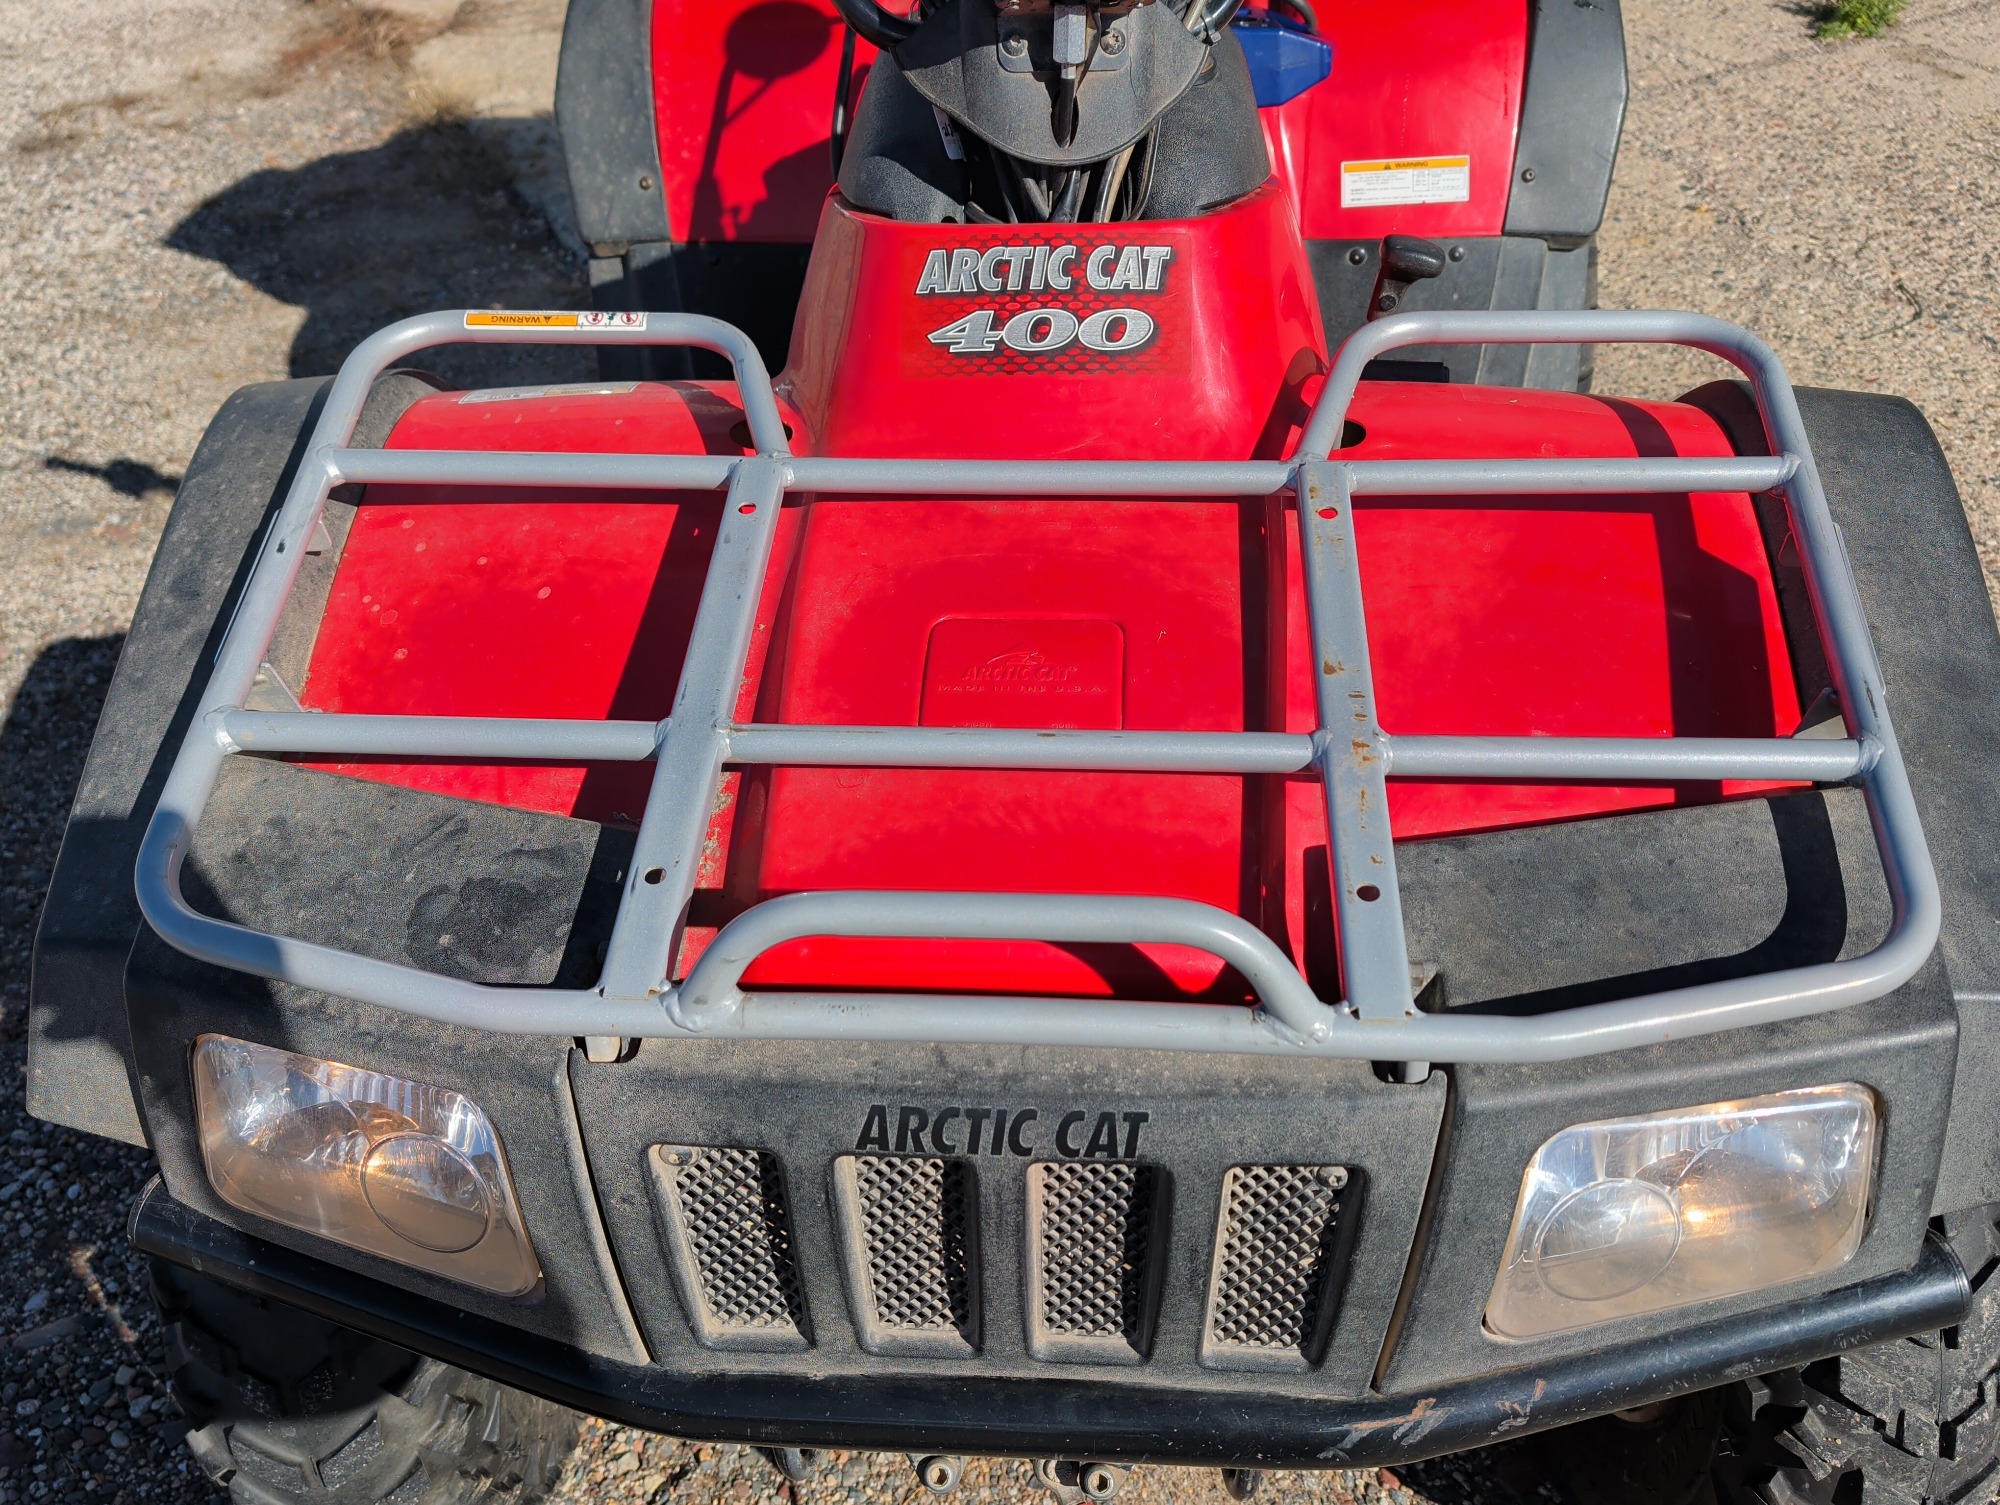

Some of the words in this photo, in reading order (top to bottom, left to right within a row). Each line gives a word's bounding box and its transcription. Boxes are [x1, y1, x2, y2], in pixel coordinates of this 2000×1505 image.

[915, 245, 1076, 294] ARCTIC
[1086, 245, 1172, 291] CAT
[491, 315, 540, 324] WARNING
[926, 308, 1154, 353] 400
[961, 664, 1031, 681] ARCTIC
[855, 1104, 1038, 1157] ARCTIC
[1055, 1110, 1150, 1159] CAT
